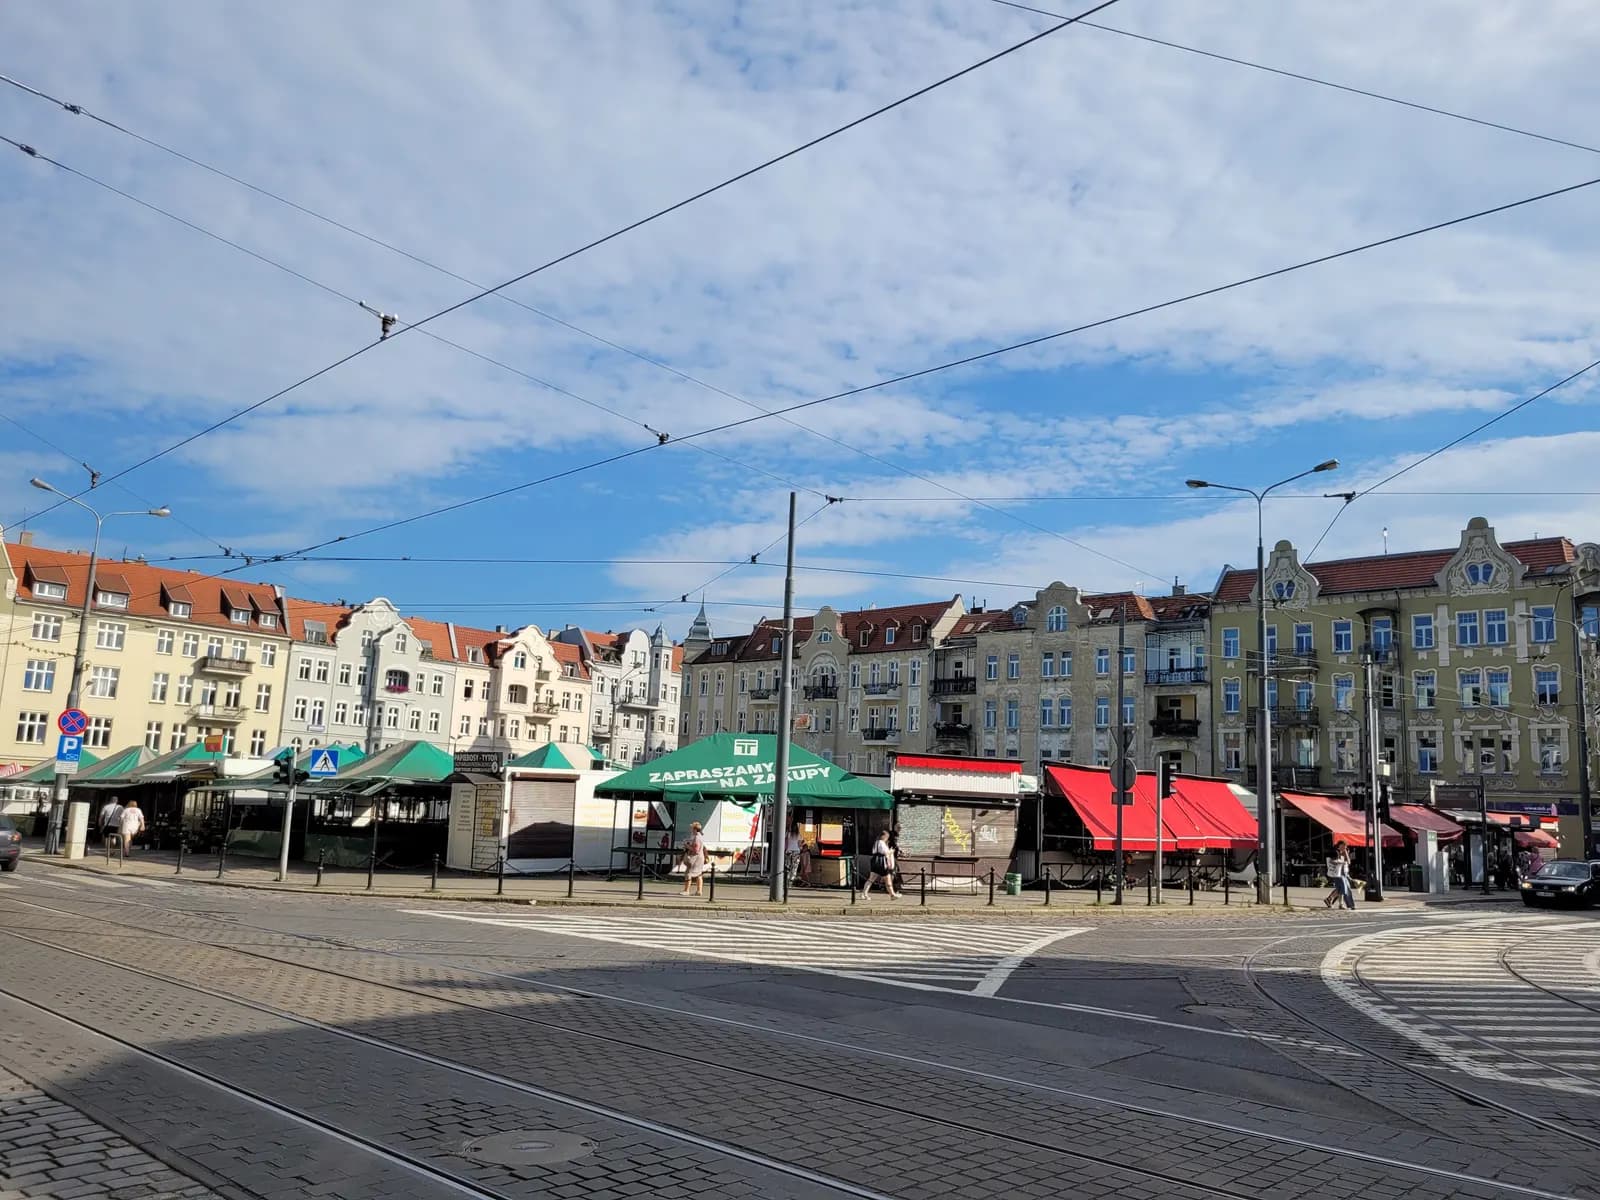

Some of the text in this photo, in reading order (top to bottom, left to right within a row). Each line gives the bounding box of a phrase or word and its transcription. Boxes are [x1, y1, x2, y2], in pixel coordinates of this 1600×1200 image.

[62, 738, 78, 754] P
[648, 762, 774, 783] ZAPRASZAMY
[719, 777, 748, 788] NA
